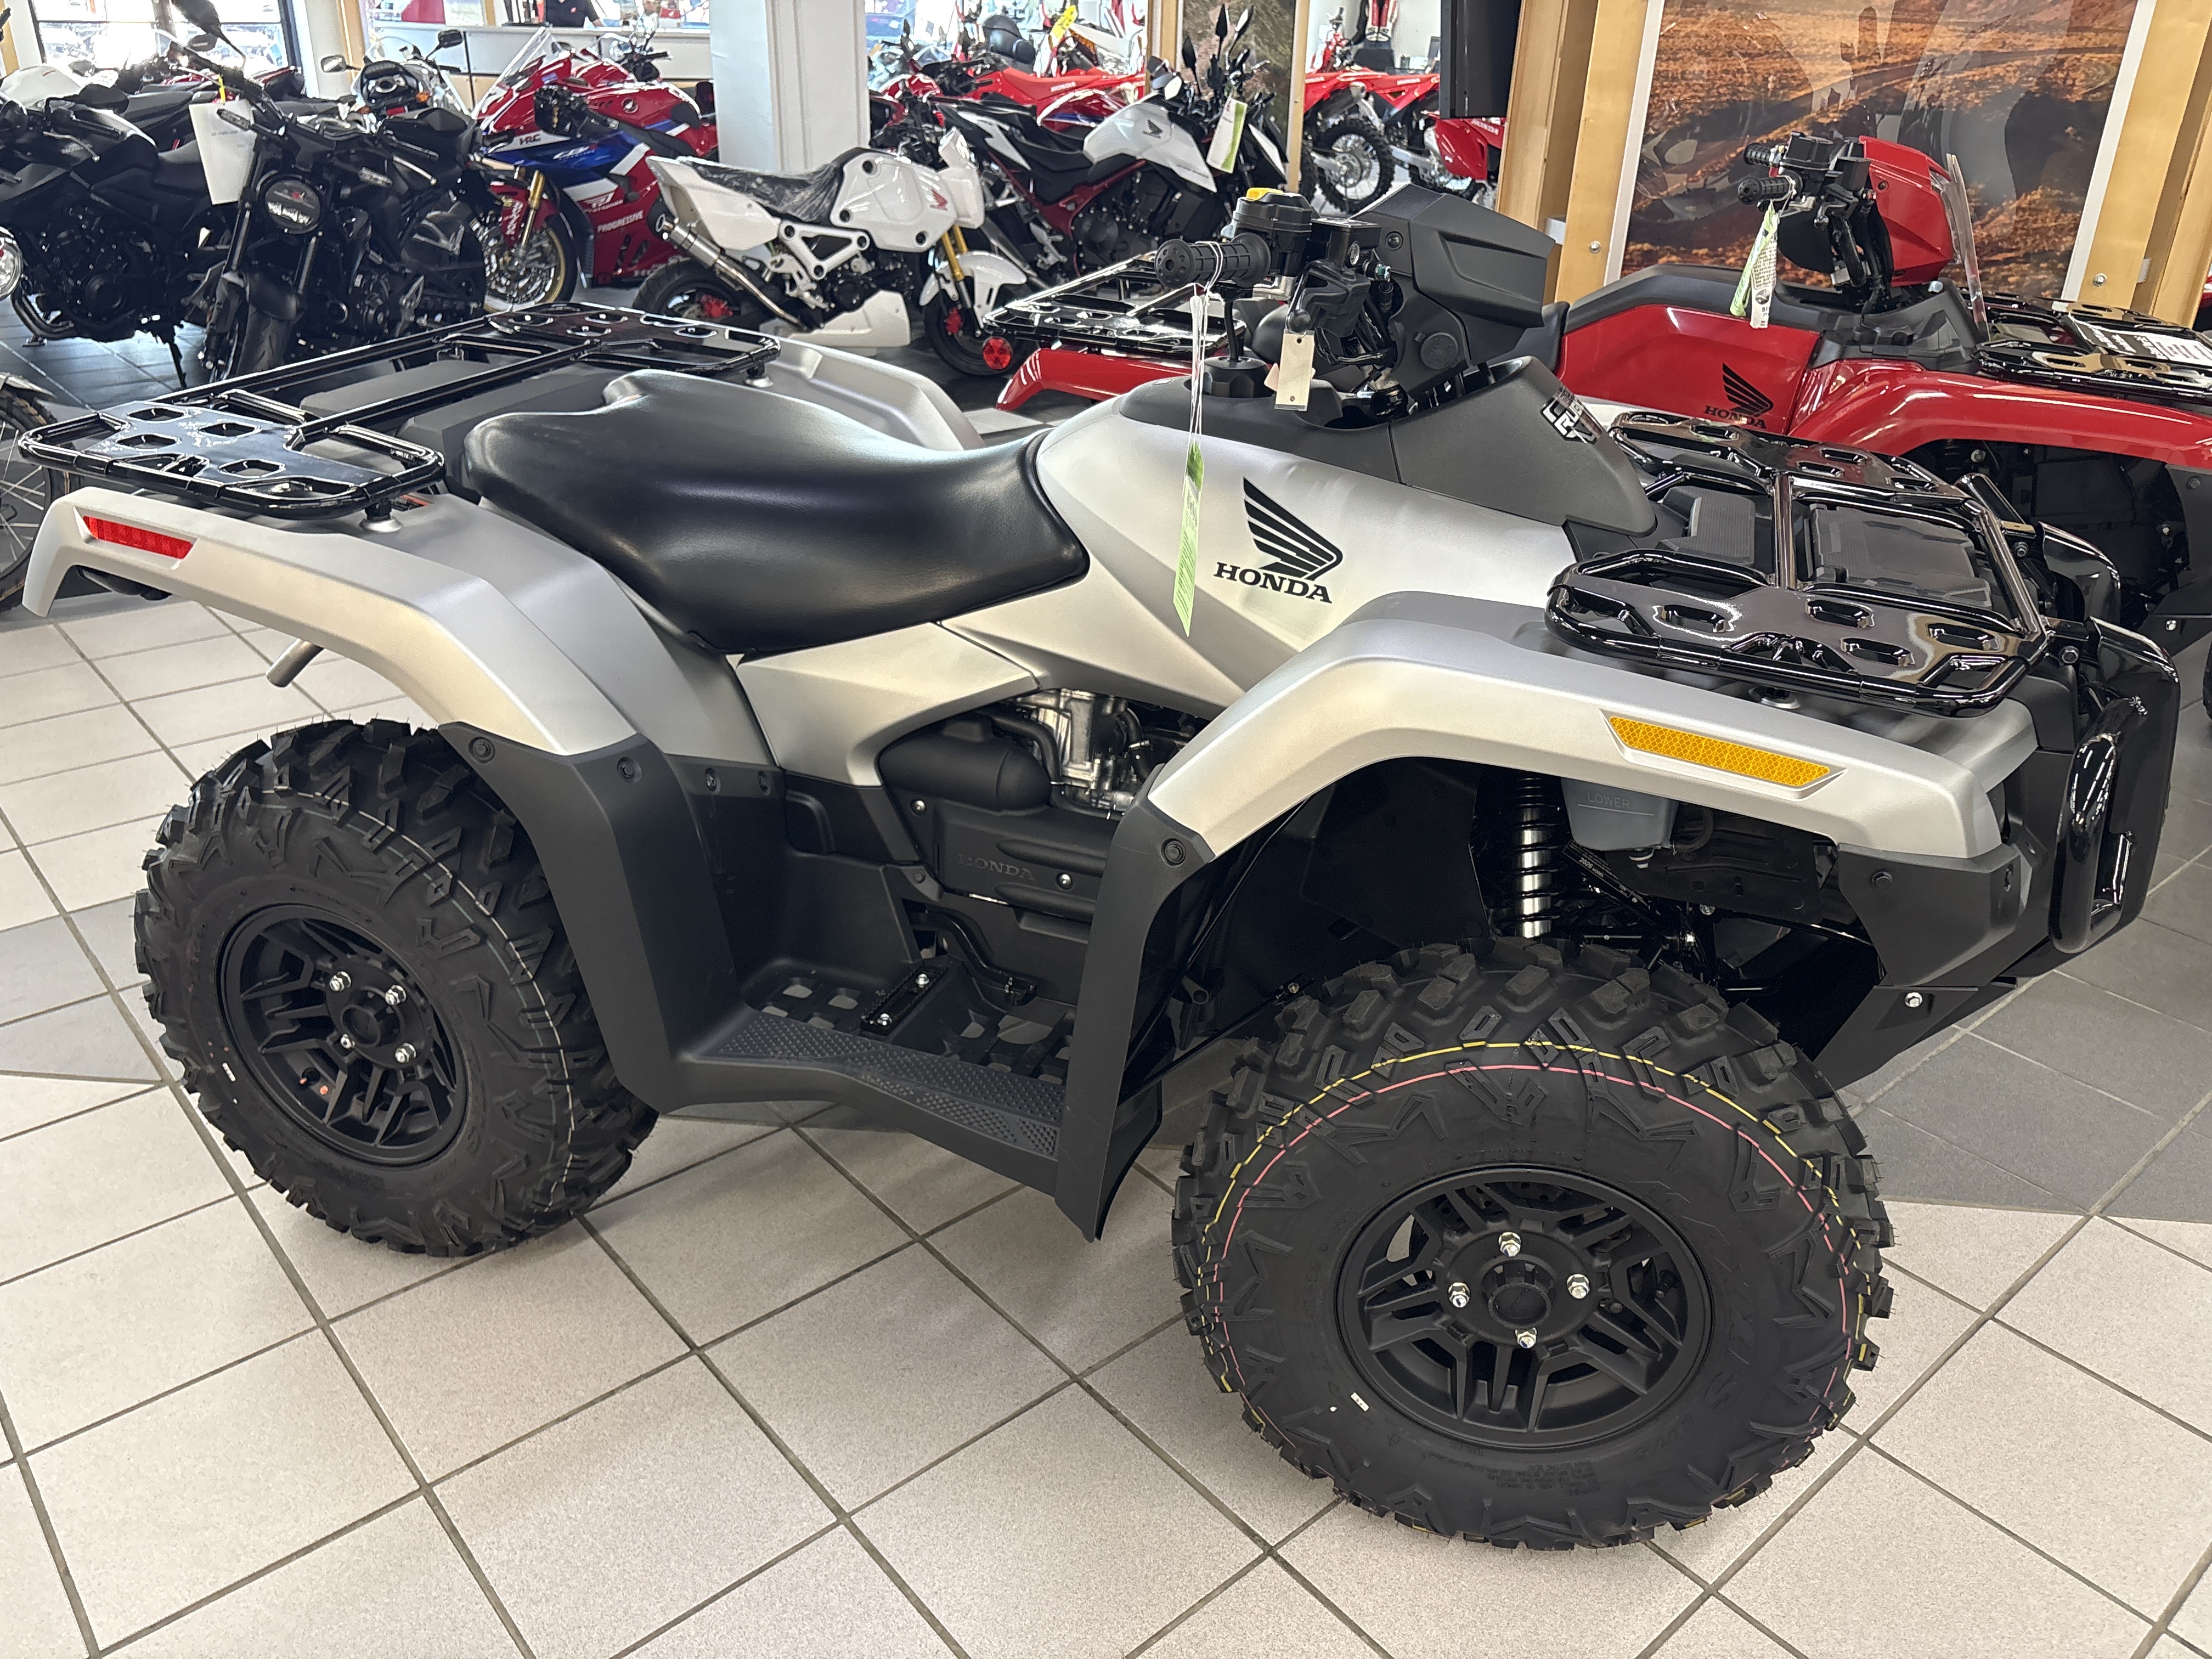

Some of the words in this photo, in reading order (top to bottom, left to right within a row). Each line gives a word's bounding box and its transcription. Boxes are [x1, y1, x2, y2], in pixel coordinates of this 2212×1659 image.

[519, 133, 541, 145] HRC
[597, 210, 645, 234] PROGRESSIVE
[1704, 405, 1768, 430] HONDA
[1214, 561, 1333, 604] HONDA
[1587, 791, 1631, 810] LOWER
[956, 853, 1037, 882] HONDA
[1578, 857, 1594, 870] 2026
[1592, 867, 1604, 878] MODEL
